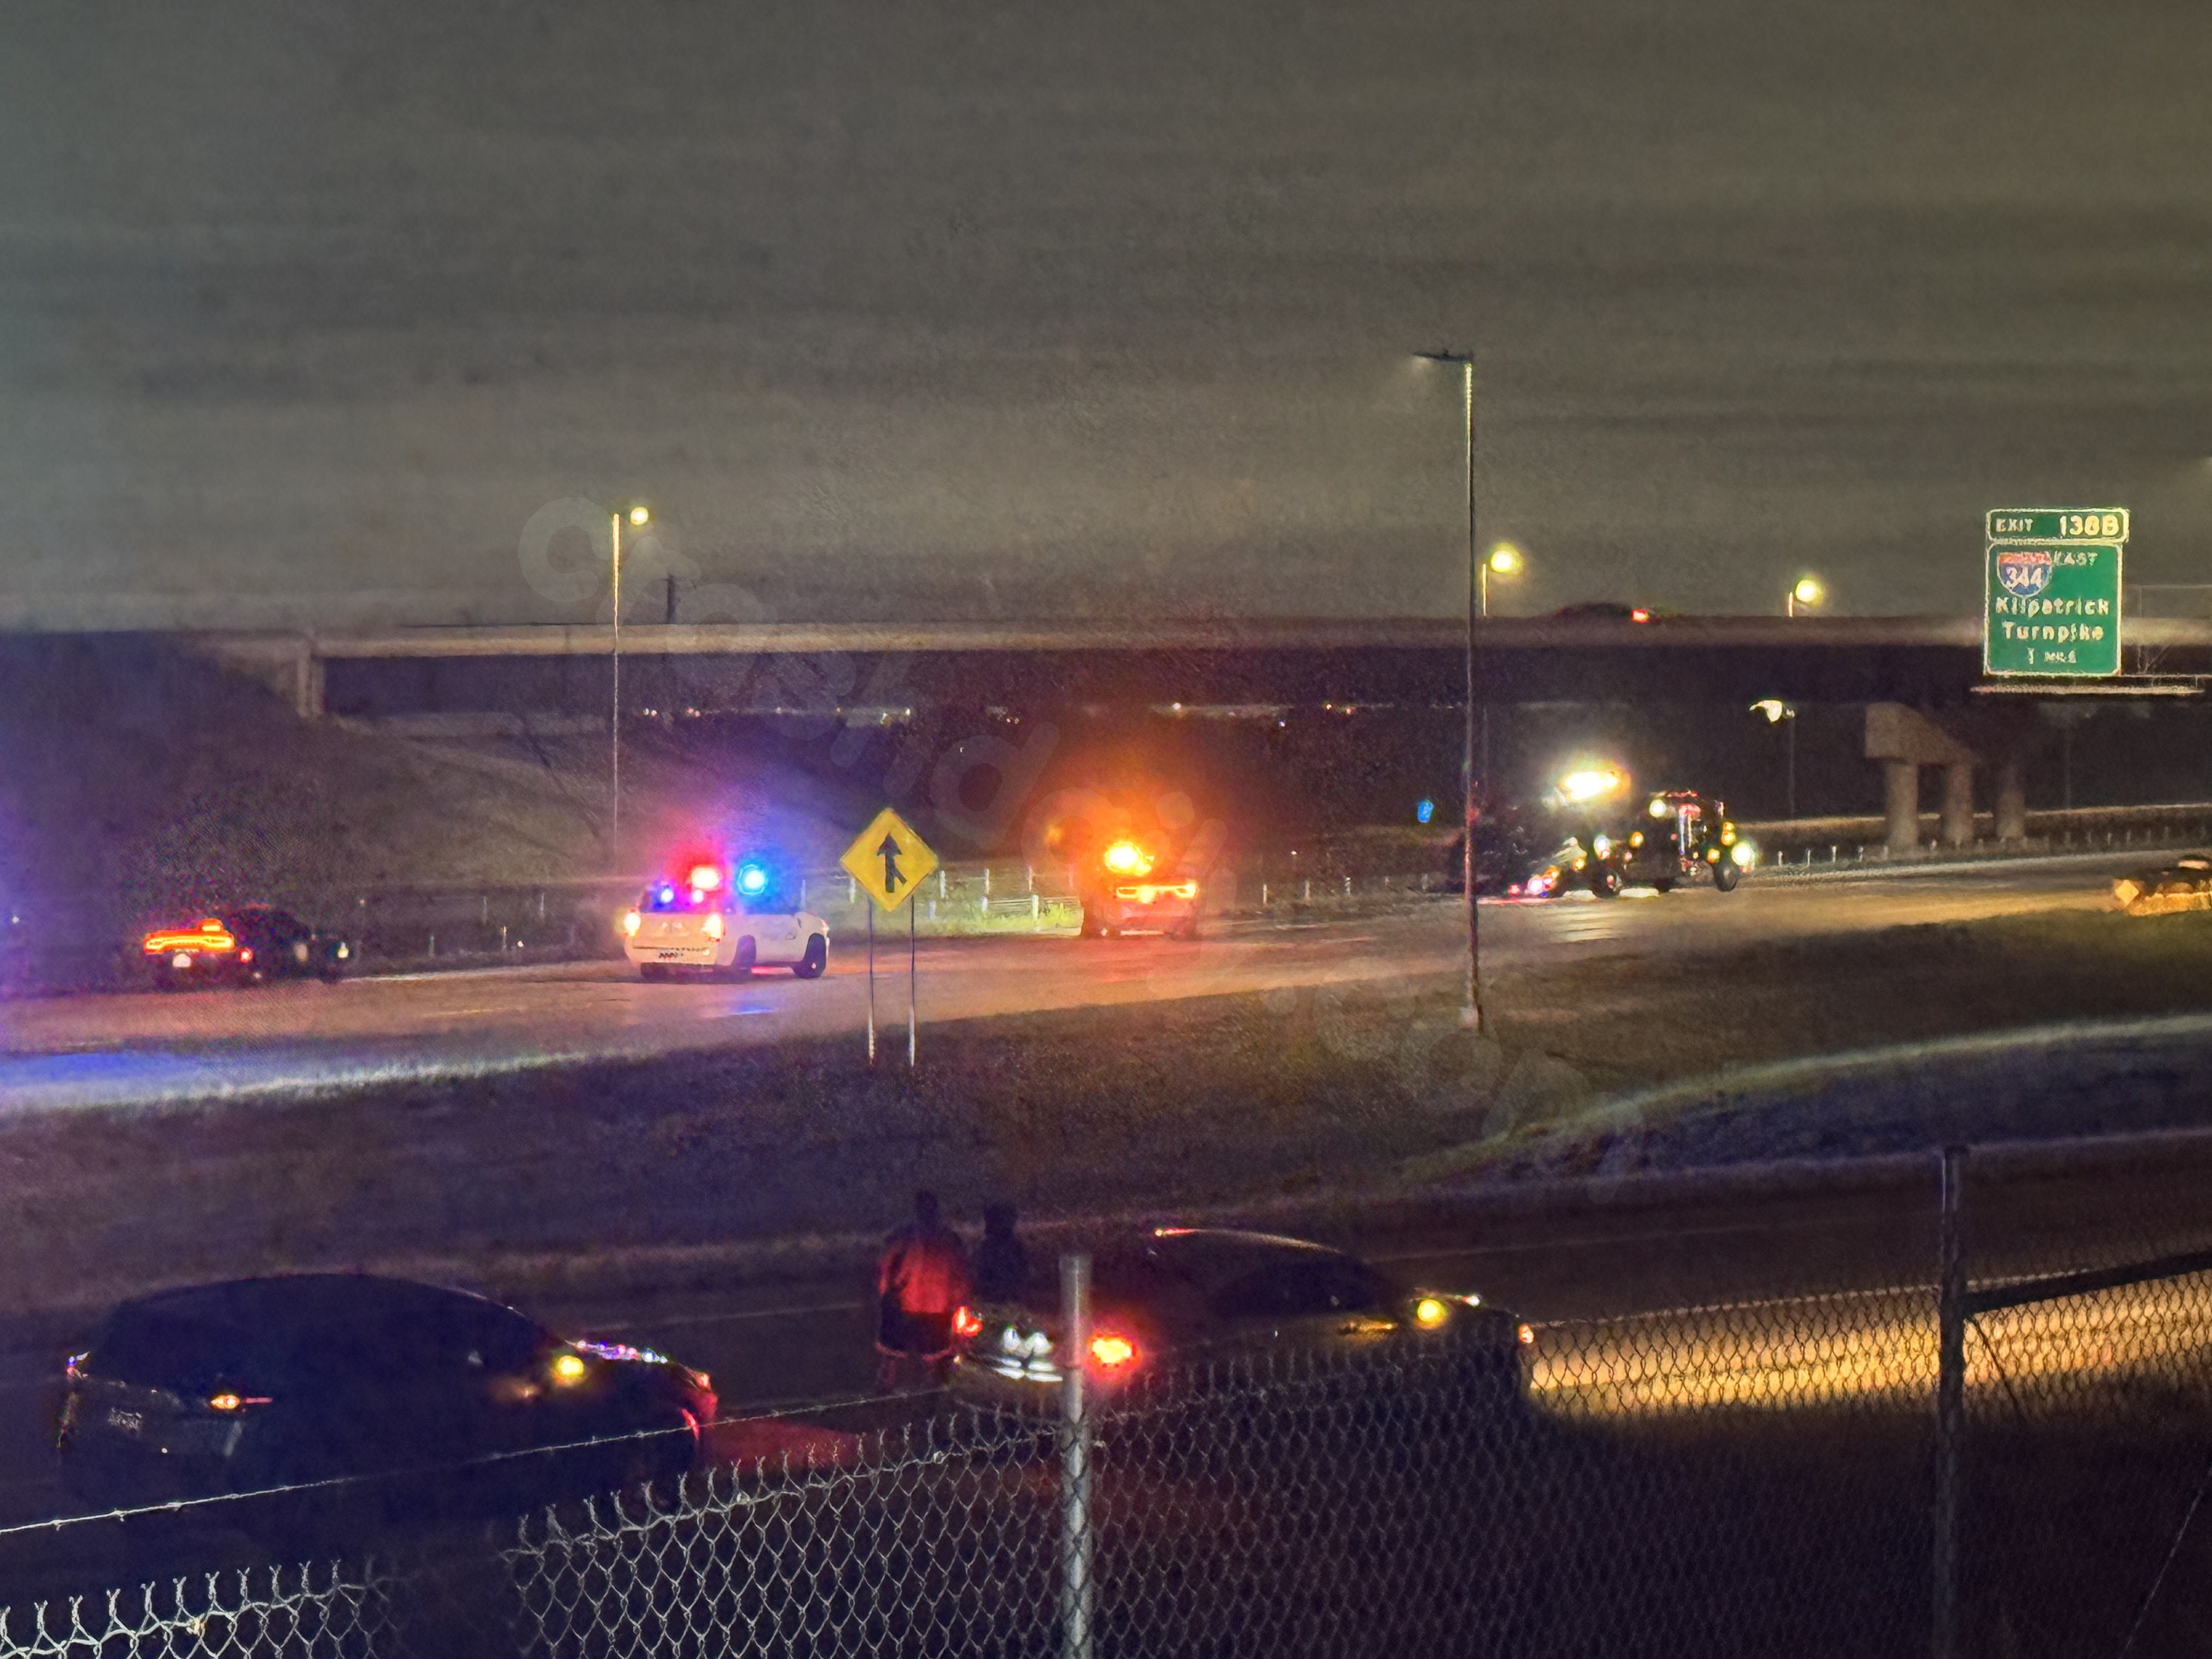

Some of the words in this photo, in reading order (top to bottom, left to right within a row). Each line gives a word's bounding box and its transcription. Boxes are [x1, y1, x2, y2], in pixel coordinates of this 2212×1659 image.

[1996, 518, 2033, 532] EXIT
[1996, 596, 2109, 618] Kilpatrick
[2002, 620, 2104, 643] Turnpike
